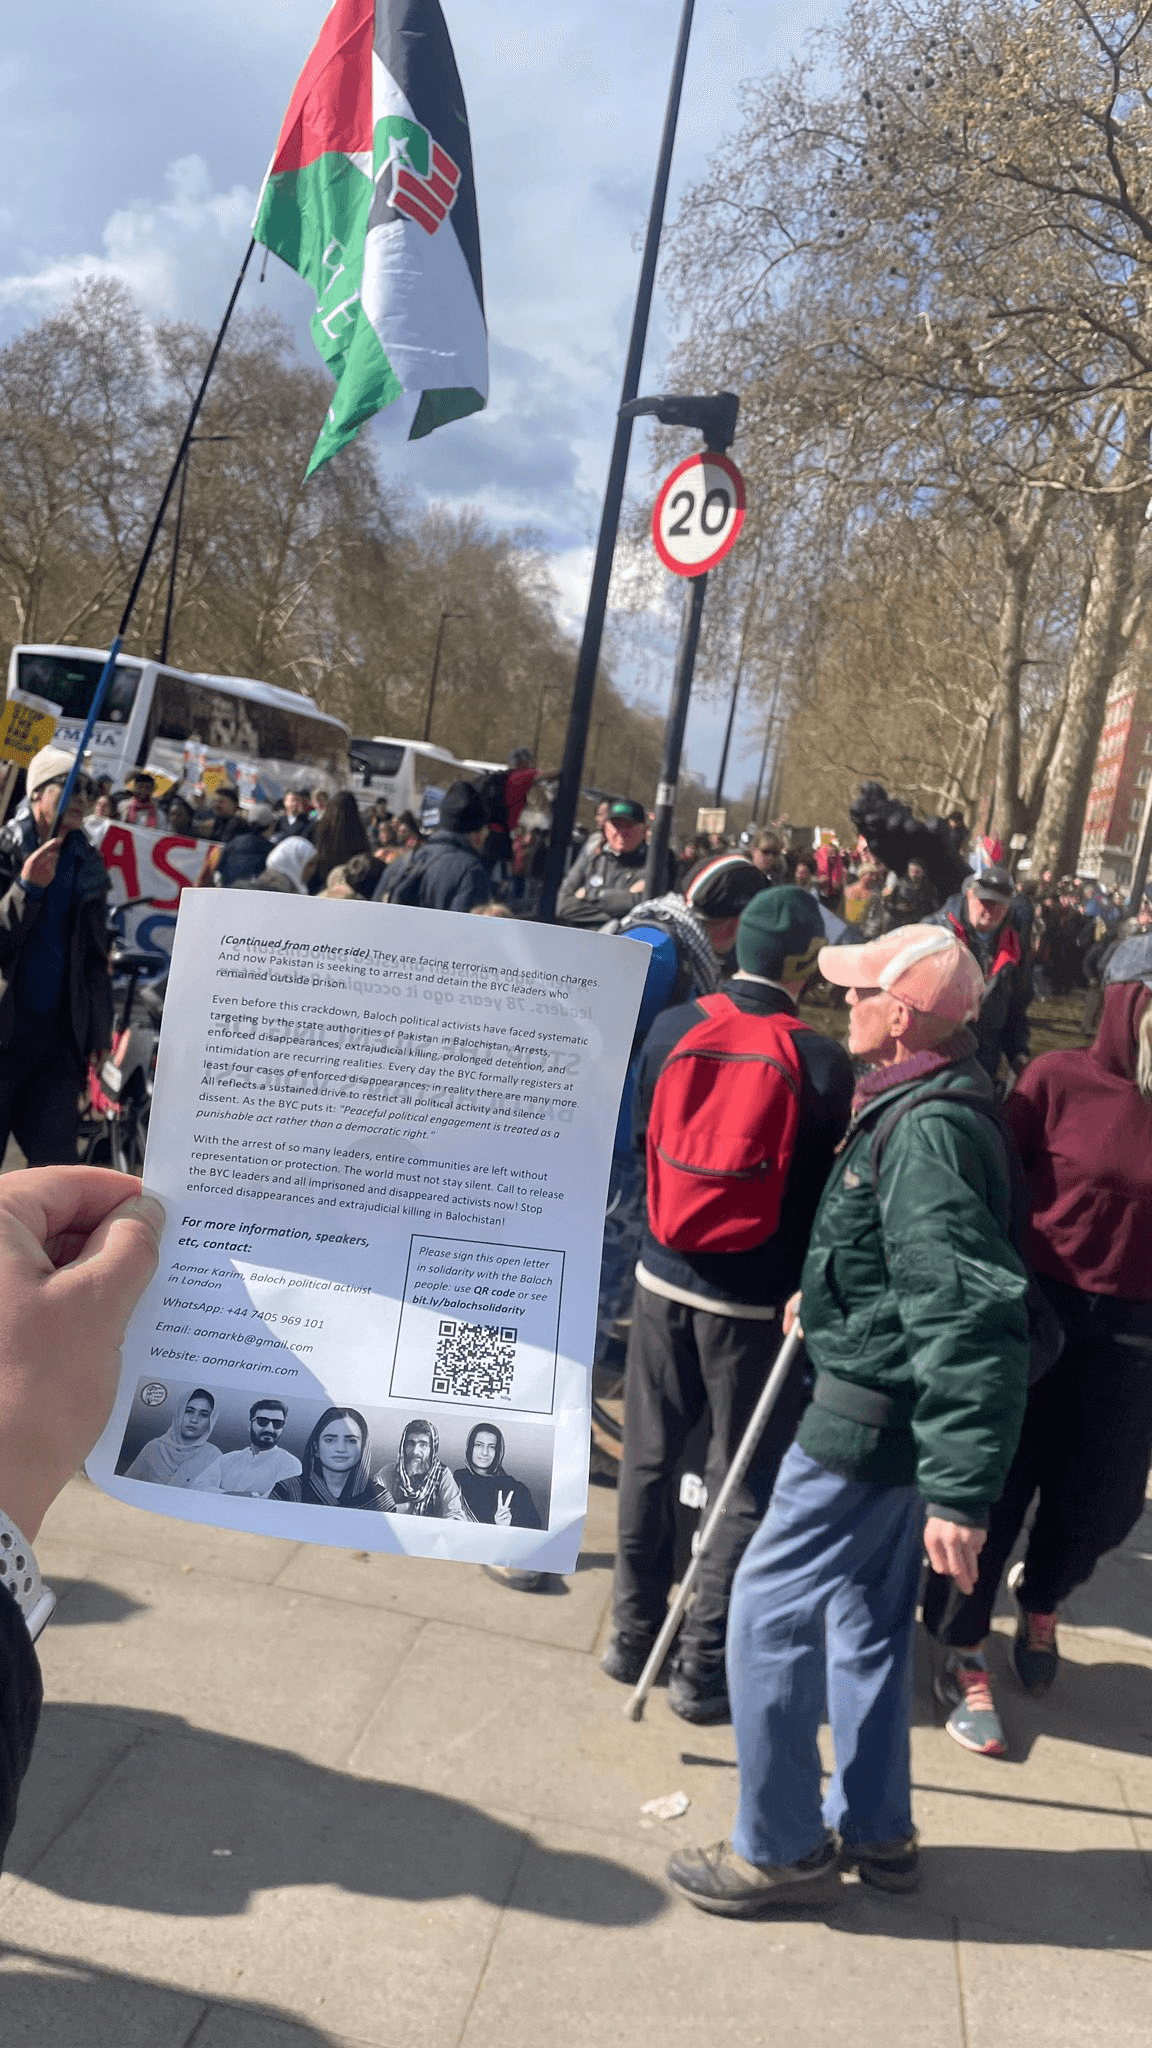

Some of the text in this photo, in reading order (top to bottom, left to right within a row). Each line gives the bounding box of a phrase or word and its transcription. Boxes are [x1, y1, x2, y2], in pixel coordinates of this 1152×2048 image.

[669, 488, 730, 536] 20
[216, 970, 268, 981] remained
[269, 975, 310, 985] outside
[218, 950, 569, 998] And now Pakistan is seeking to arrest and detain the BYC leaders who
[282, 940, 310, 951] from
[312, 944, 345, 955] other
[373, 950, 398, 964] They
[400, 956, 416, 964] are
[419, 955, 449, 970] facing
[452, 960, 498, 973] terrorism
[500, 967, 519, 976] and
[521, 969, 558, 981] sedition
[212, 994, 238, 1005] Even
[242, 997, 277, 1009] before
[280, 1001, 299, 1011] this
[364, 1010, 397, 1022] Baloch
[400, 1015, 440, 1027] political
[442, 1021, 481, 1032] activists
[483, 1024, 507, 1035] have
[510, 1027, 536, 1038] faced
[538, 1033, 588, 1045] systematic
[206, 1042, 270, 1057] intimidation
[293, 1054, 340, 1067] recurring
[388, 1061, 416, 1075] Every
[418, 1064, 437, 1077] day
[439, 1067, 455, 1077] the
[458, 1069, 477, 1079] BYC
[479, 1071, 519, 1087] formally
[520, 1078, 562, 1089] registers
[564, 1082, 574, 1091] at
[196, 1109, 254, 1121] punishable
[256, 1115, 273, 1123] act
[275, 1116, 308, 1126] rather
[310, 1118, 334, 1129] than
[344, 1121, 402, 1136] democratic
[242, 1095, 256, 1105] As
[258, 1097, 276, 1107] the
[278, 1098, 299, 1109] BYC
[301, 1103, 323, 1112] puts
[388, 1111, 428, 1122] political
[430, 1117, 491, 1130] engagement
[493, 1122, 501, 1131] is
[503, 1124, 540, 1136] treated
[194, 1134, 219, 1144] With
[222, 1137, 239, 1146] the
[242, 1141, 272, 1150] arrest
[275, 1142, 287, 1151] of
[302, 1147, 331, 1158] many
[375, 1154, 405, 1164] entire
[408, 1158, 471, 1171] communities
[492, 1165, 508, 1176] left
[510, 1169, 548, 1181] without
[186, 1183, 234, 1195] enforced
[236, 1186, 315, 1204] disappearances
[318, 1197, 337, 1206] and
[339, 1200, 400, 1213] extrajudicial
[402, 1205, 431, 1219] killing
[434, 1209, 443, 1218] in
[189, 1166, 207, 1176] the
[210, 1167, 230, 1178] BYC
[232, 1170, 270, 1182] leaders
[272, 1175, 292, 1184] and
[294, 1177, 307, 1186] all
[308, 1178, 366, 1192] imprisoned
[367, 1186, 387, 1195] and
[389, 1186, 450, 1202] disappeared
[452, 1196, 491, 1207] activists
[520, 1202, 543, 1216] Stop
[181, 1216, 203, 1228] For
[204, 1222, 236, 1232] more
[416, 1263, 553, 1285] in solidarity with the Baloch
[418, 1246, 551, 1268] Please sign this open letter
[168, 1273, 222, 1289] in London
[170, 1260, 210, 1275] Aomar
[250, 1272, 286, 1285] Baloch
[288, 1278, 332, 1290] political
[333, 1284, 372, 1294] activist
[474, 1285, 490, 1297] QR
[491, 1288, 516, 1298] code
[530, 1293, 548, 1301] see
